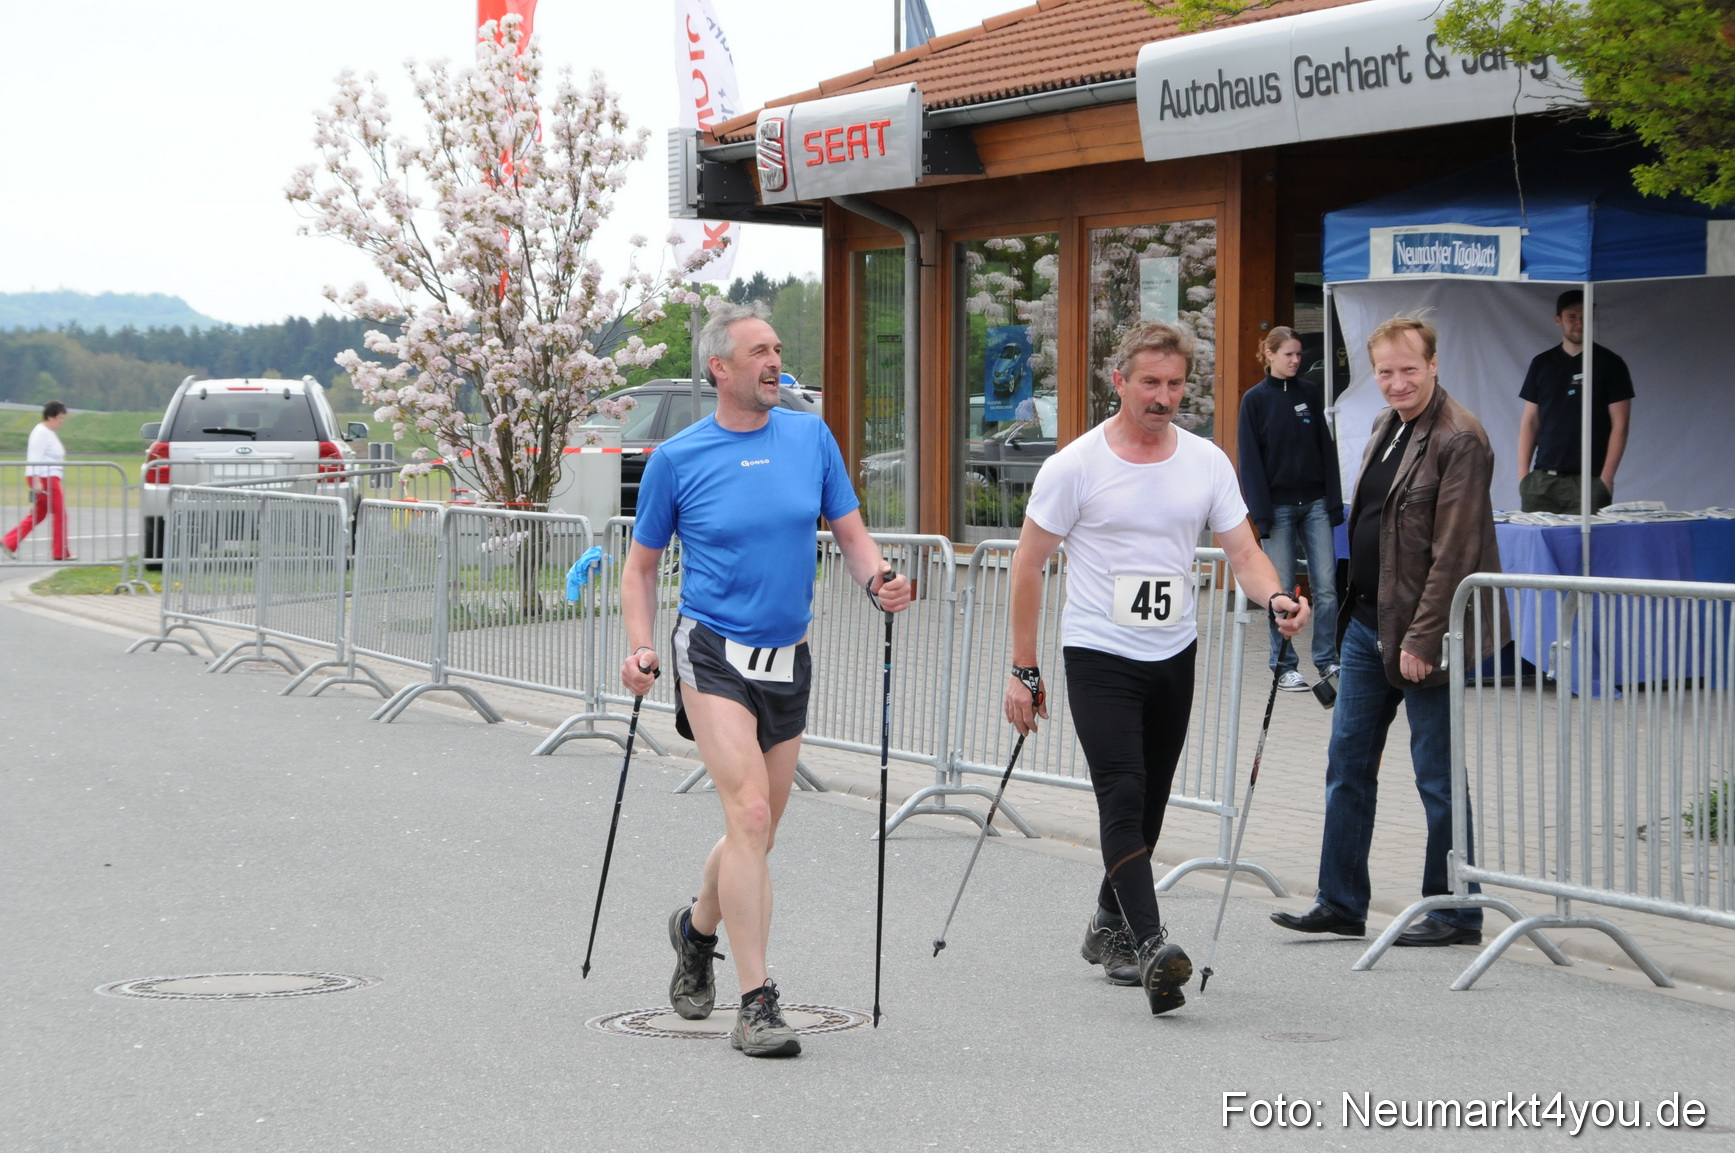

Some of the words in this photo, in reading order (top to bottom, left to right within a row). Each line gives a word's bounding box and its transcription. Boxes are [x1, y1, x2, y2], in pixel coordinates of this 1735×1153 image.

[1159, 68, 1282, 121] Autohaus
[1293, 44, 1413, 98] Gerhart
[1425, 33, 1450, 80] &
[803, 118, 891, 167] SEAT
[1452, 240, 1496, 269] Tagblatt
[1130, 580, 1171, 621] 45
